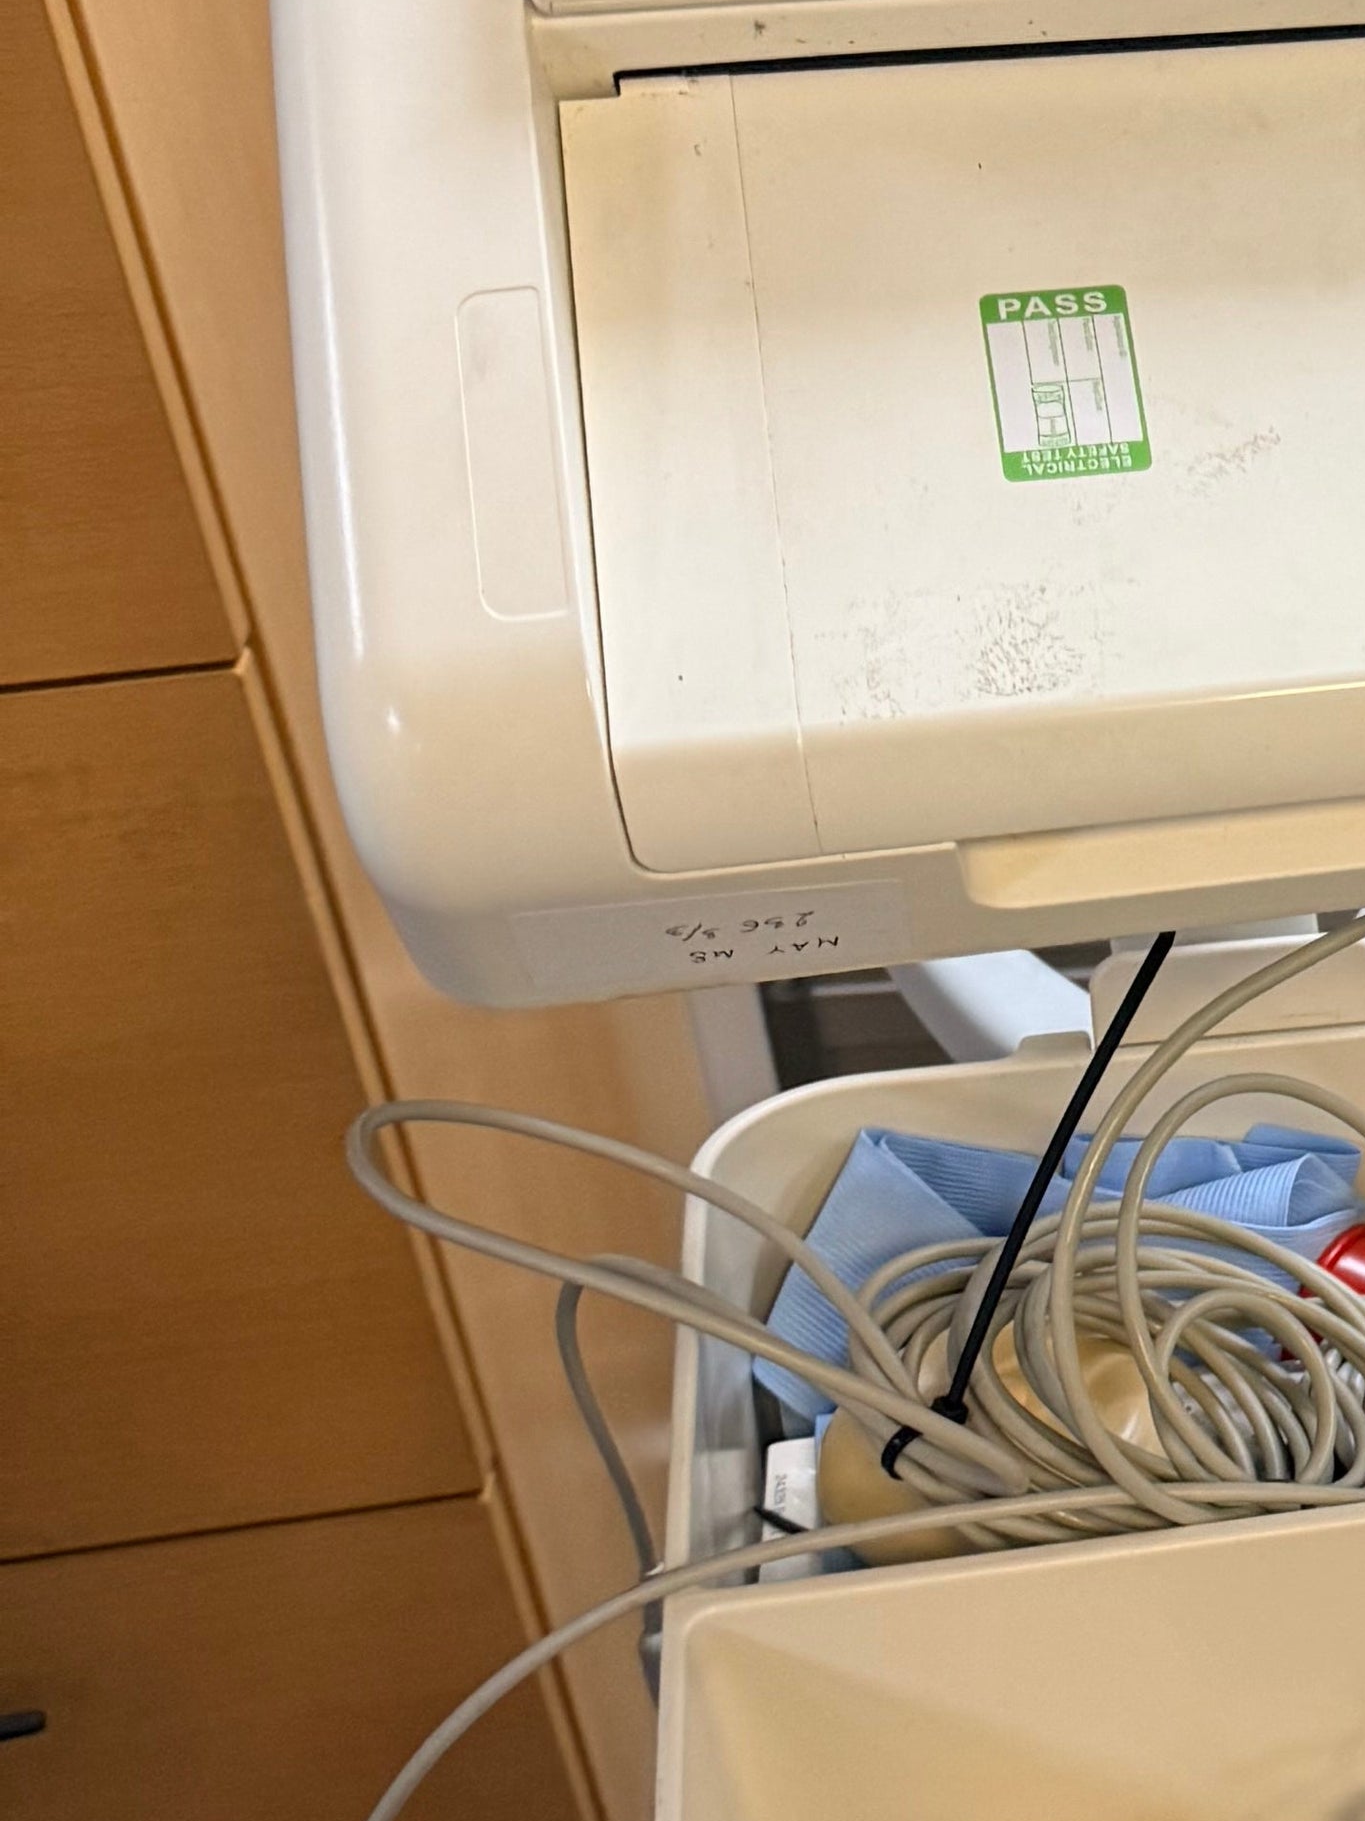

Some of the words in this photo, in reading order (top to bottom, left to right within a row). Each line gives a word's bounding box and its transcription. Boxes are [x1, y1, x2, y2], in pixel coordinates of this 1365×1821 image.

[998, 292, 1107, 321] PASS
[1021, 448, 1063, 465] TEST
[1068, 442, 1130, 459] SAFETY
[1022, 454, 1132, 476] ELECTRICAL
